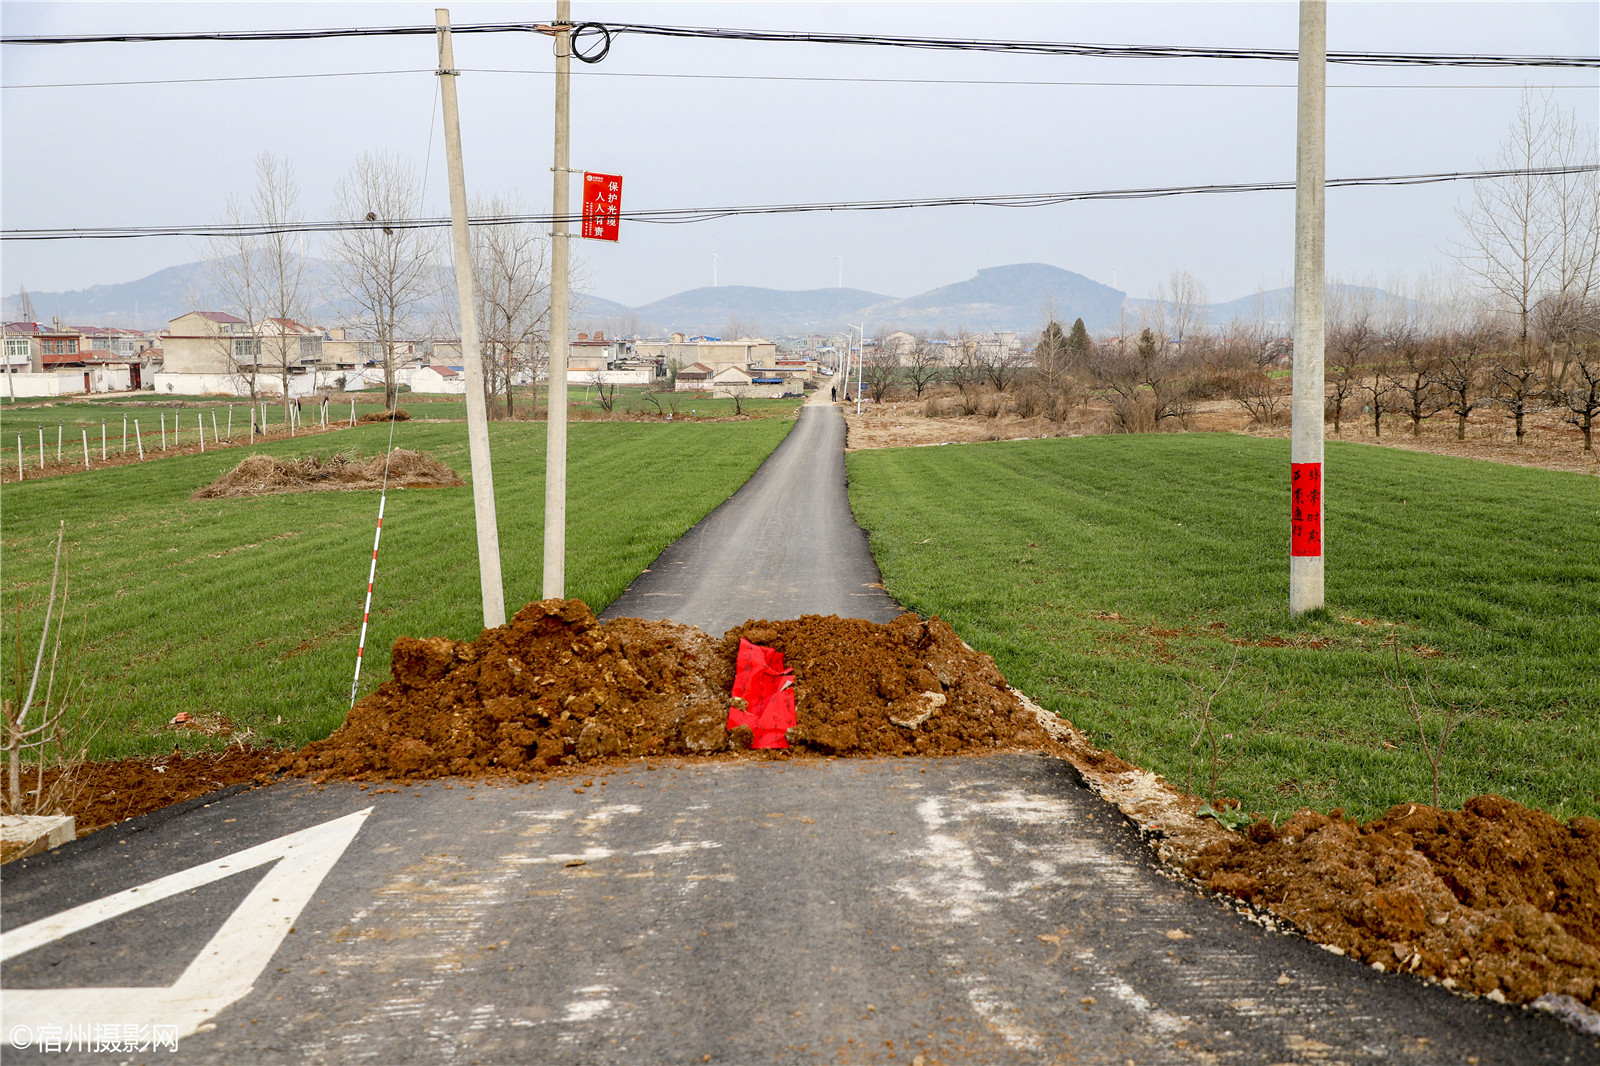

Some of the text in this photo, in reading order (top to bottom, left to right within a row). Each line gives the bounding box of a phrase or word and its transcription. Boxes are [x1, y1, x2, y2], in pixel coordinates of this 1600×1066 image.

[593, 191, 606, 237] 人人有责
[606, 181, 619, 227] 保护光缆
